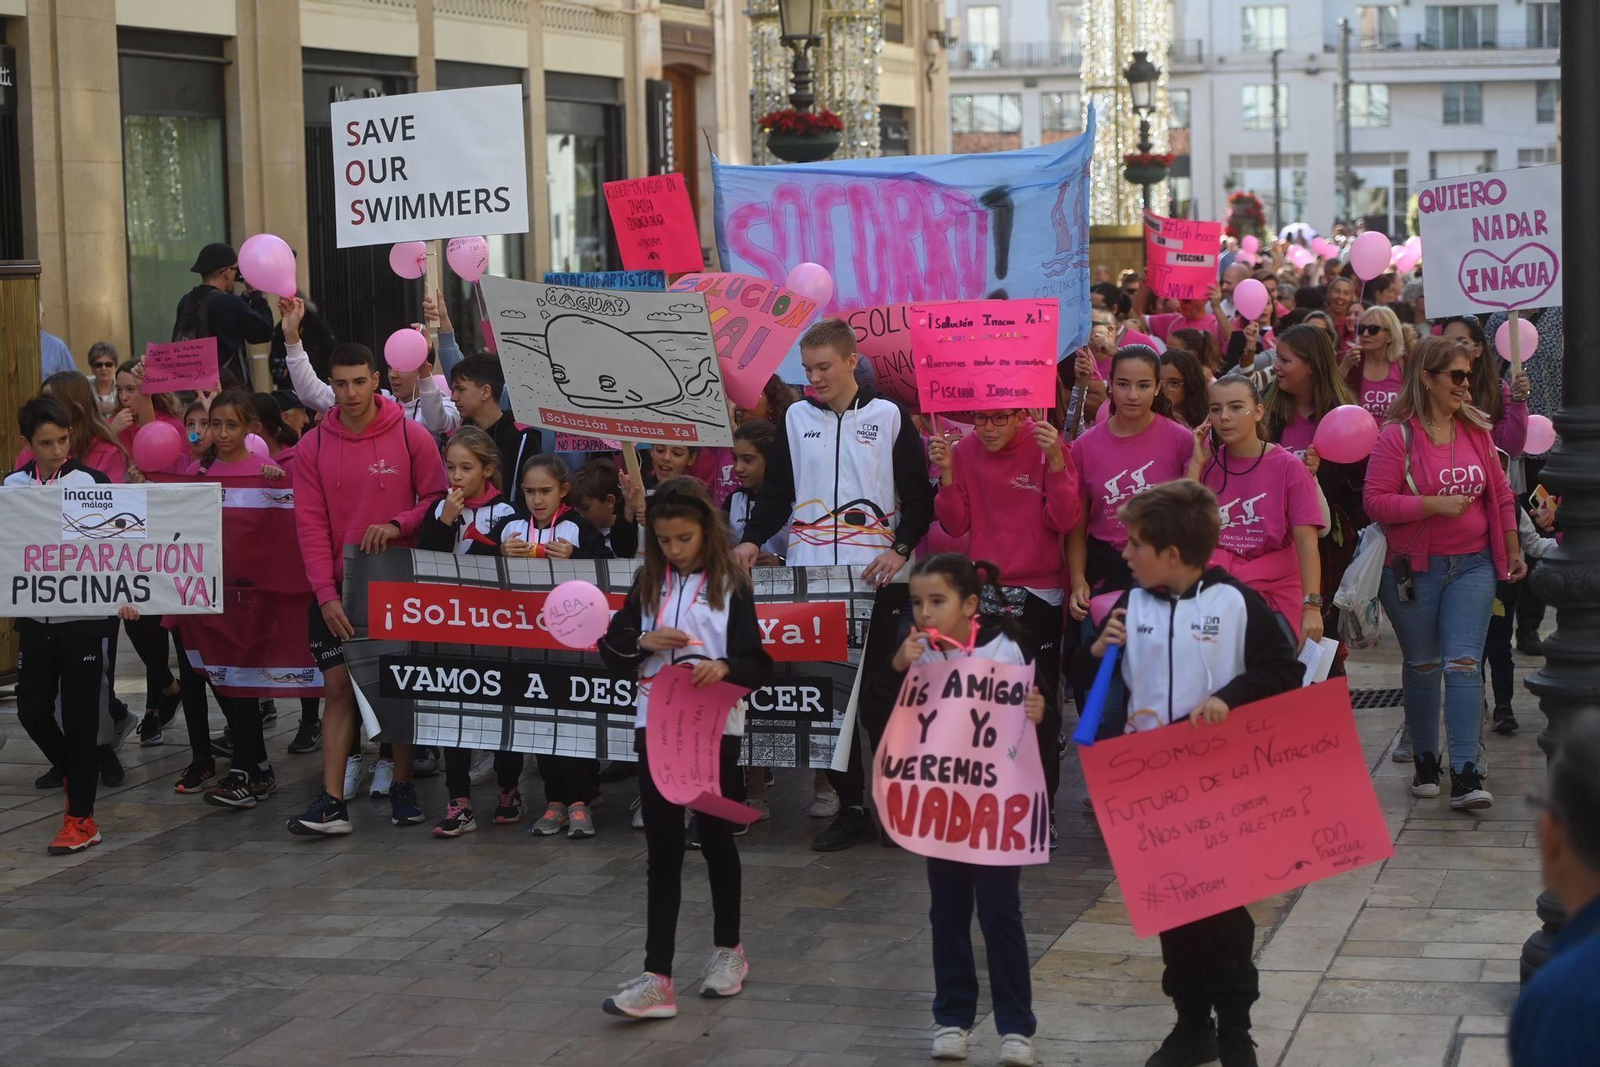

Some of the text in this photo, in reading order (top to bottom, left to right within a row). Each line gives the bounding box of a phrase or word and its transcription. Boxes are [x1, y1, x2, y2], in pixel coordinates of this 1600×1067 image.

[346, 115, 416, 147] SAVE
[345, 156, 408, 186] OUR
[351, 186, 511, 226] SWIMMERS
[1418, 178, 1507, 214] QUIERO
[1472, 209, 1548, 243] NADAR
[1176, 253, 1205, 263] PISCINA
[1466, 261, 1550, 293] INACUA
[1025, 309, 1043, 325] Ya!
[541, 412, 697, 439] ¡Solución Inacua Ya!
[558, 440, 569, 450] NO
[64, 488, 113, 501] inacua
[81, 501, 114, 511] málaga
[24, 532, 204, 573] REPARACIÓN
[12, 574, 217, 608] PISCINAS YA!
[549, 598, 584, 620] ALBA
[759, 616, 822, 645] Ya!
[389, 665, 502, 697] VAMOS
[524, 673, 549, 700] A
[917, 709, 938, 744] Y
[1108, 718, 1277, 784] SOMOS EL
[1104, 785, 1190, 827] FUTURO
[1199, 773, 1223, 794] DE
[1232, 763, 1250, 781] LA
[886, 782, 1048, 854] NADAR!!
[1137, 822, 1182, 852] ¿NOS
[1184, 813, 1211, 833] VAS
[1214, 811, 1226, 825] A
[1205, 830, 1229, 850] LAS
